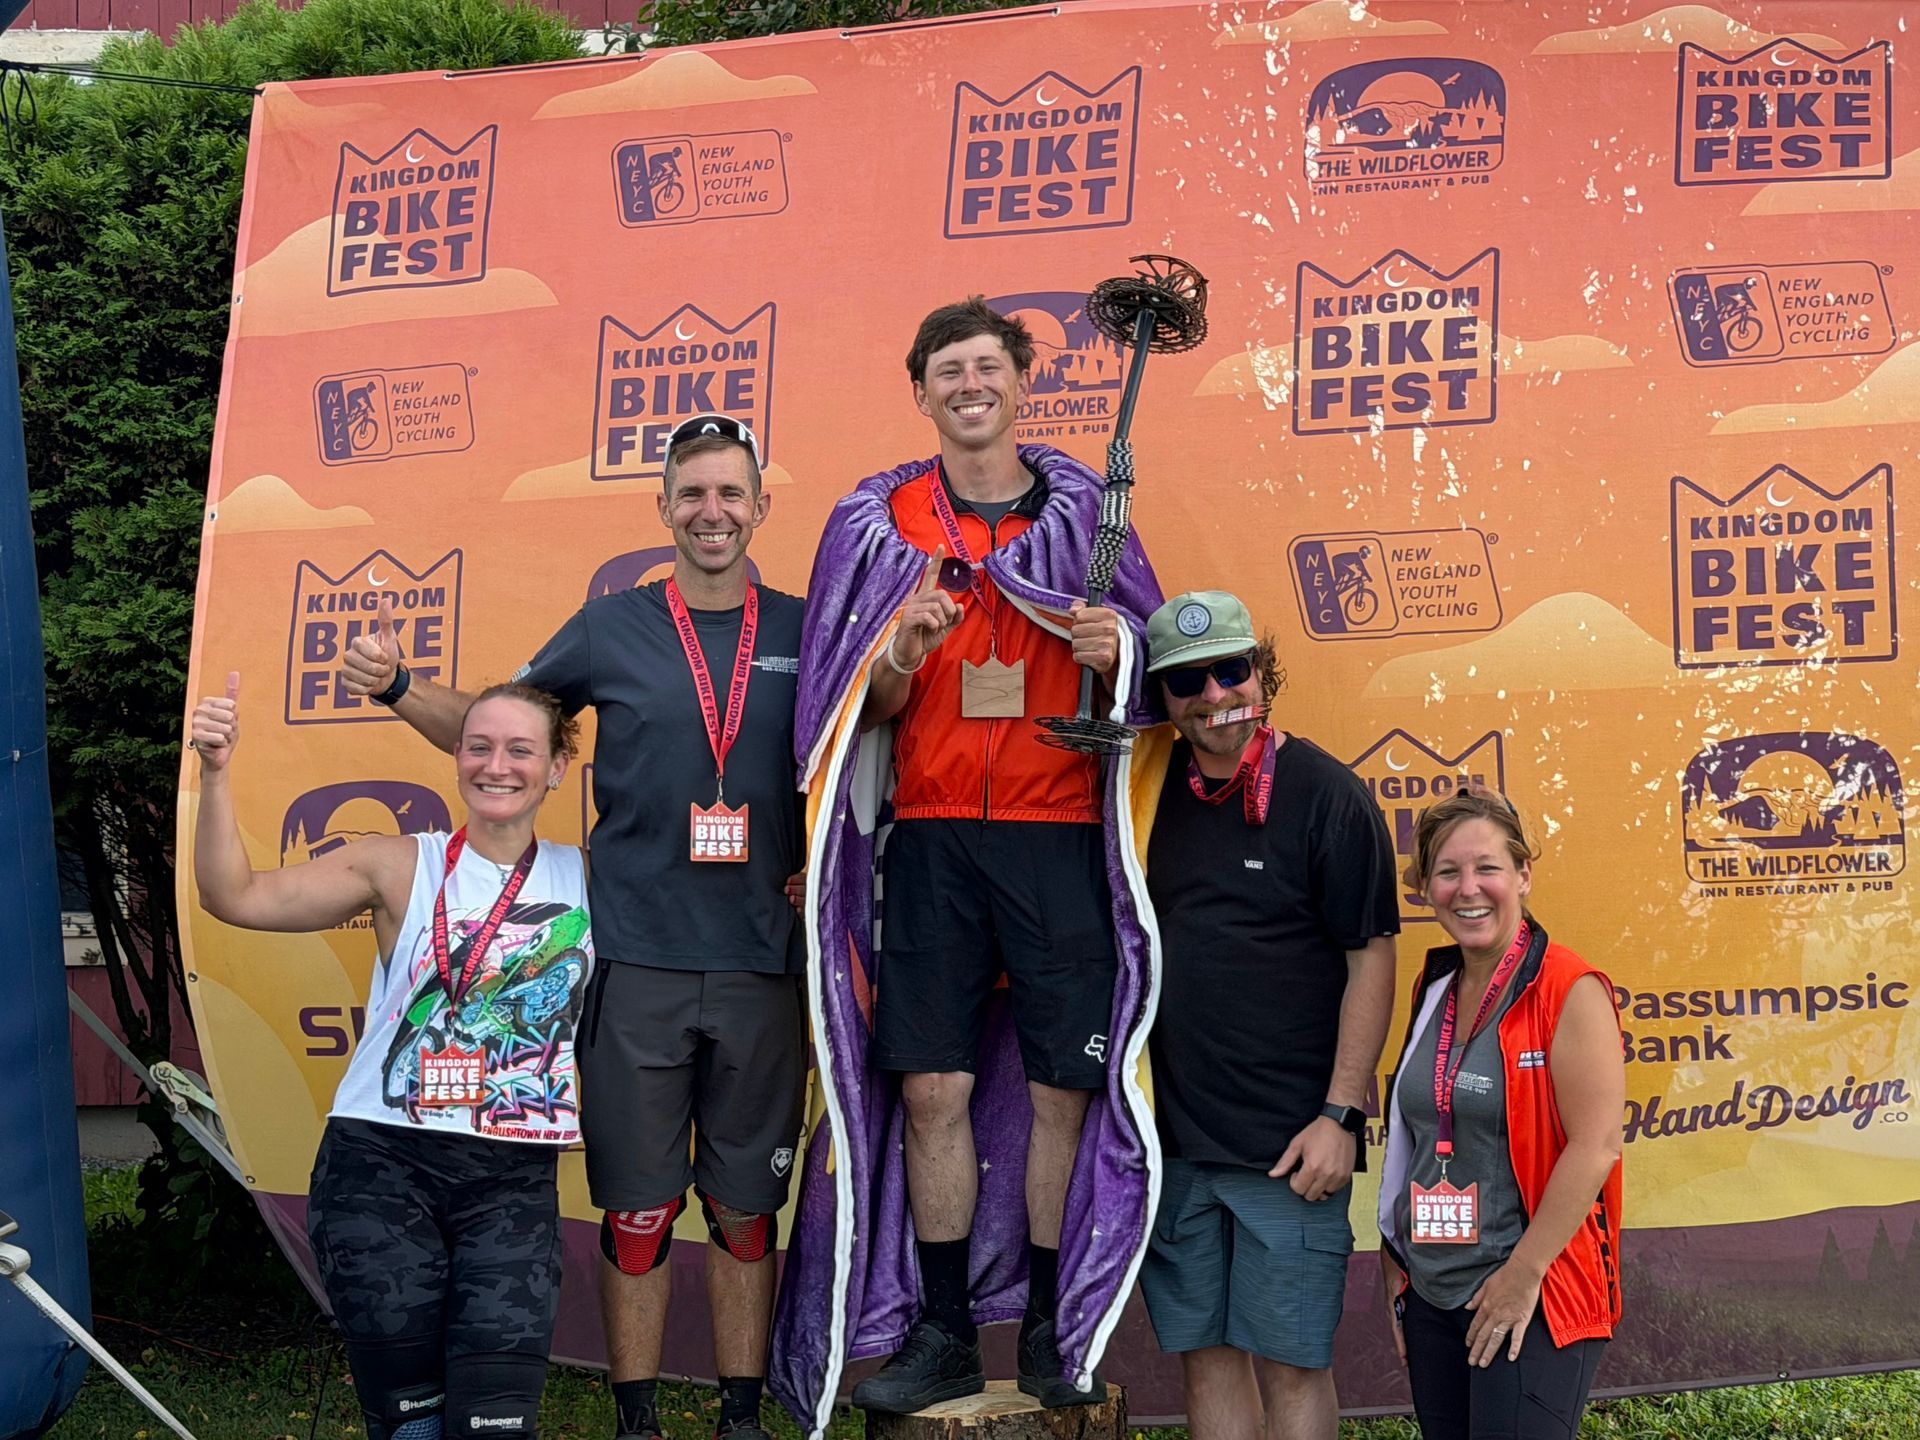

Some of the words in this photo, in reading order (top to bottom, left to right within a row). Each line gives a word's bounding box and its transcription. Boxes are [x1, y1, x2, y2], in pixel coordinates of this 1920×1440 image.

[1697, 69, 1871, 87] KINGDOM
[969, 102, 1121, 133] KINGDOM
[1696, 92, 1871, 130] BIKE
[700, 146, 735, 160] NEW
[965, 129, 1118, 180] BIKE
[1317, 159, 1351, 178] THE
[1359, 151, 1489, 175] WILDFLOWER
[1694, 134, 1871, 172] FEST
[350, 160, 479, 193] KINGDOM
[702, 159, 775, 175] ENGLAND
[703, 176, 753, 191] YOUTH
[1345, 178, 1441, 194] RESTAURANT
[1447, 177, 1454, 186] &
[1462, 175, 1489, 185] PUB
[344, 186, 476, 237] BIKE
[704, 191, 769, 206] CYCLING
[961, 176, 1116, 224] FEST
[340, 232, 472, 281] FEST
[1778, 278, 1821, 292] NEW
[1314, 287, 1479, 318] KINGDOM
[1783, 293, 1874, 309] ENGLAND
[1786, 312, 1847, 327] YOUTH
[1312, 316, 1477, 370] BIKE
[1790, 328, 1870, 344] CYCLING
[613, 340, 757, 369] KINGDOM
[392, 381, 424, 394] NEW
[609, 368, 755, 419] BIKE
[1311, 368, 1477, 419] FEST
[393, 394, 460, 410] ENGLAND
[395, 412, 440, 427] YOUTH
[1069, 426, 1076, 435] &
[1083, 423, 1109, 434] PUB
[397, 427, 455, 443] CYCLING
[933, 487, 959, 538] KINGDOM
[954, 540, 971, 562] BIK
[1691, 508, 1873, 539] KINGDOM
[1391, 547, 1431, 562] NEW
[1397, 565, 1481, 581] ENGLAND
[1692, 541, 1874, 597] BIKE
[306, 587, 445, 613] KINGDOM
[1400, 585, 1457, 600] YOUTH
[1403, 602, 1479, 618] CYCLING
[741, 622, 754, 651] FEST
[1693, 600, 1874, 652] FEST
[678, 616, 705, 671] KINGDOM
[736, 652, 749, 679] BIKE
[698, 672, 713, 703] BIKE
[705, 704, 719, 736] FEST
[725, 681, 744, 742] KINGDOM
[695, 815, 744, 824] KINGDOM
[695, 824, 744, 841] BIKE
[695, 841, 744, 857] FEST
[1244, 859, 1264, 870] VANS
[1699, 857, 1739, 878] THE
[1747, 852, 1892, 877] WILDFLOWER
[1700, 887, 1728, 898] INN
[1735, 883, 1840, 897] RESTAURANT
[1846, 883, 1856, 892] &
[1862, 881, 1893, 892] PUB
[435, 915, 447, 947] BIKE
[462, 927, 495, 982] KINGDOM
[489, 897, 510, 927] BIKE
[505, 871, 524, 899] FEST
[438, 949, 450, 980] FEST
[1444, 992, 1456, 1022] FEST
[1613, 971, 1910, 1022] Passumpsic
[1438, 1022, 1453, 1050] BIKE
[1622, 1025, 1735, 1063] Bank
[425, 1058, 480, 1067] KINGDOM
[425, 1068, 480, 1084] BIKE
[424, 1085, 480, 1100] FEST
[1416, 1195, 1472, 1203] KINGDOM
[1416, 1205, 1472, 1221] BIKE
[1417, 1222, 1473, 1238] FEST
